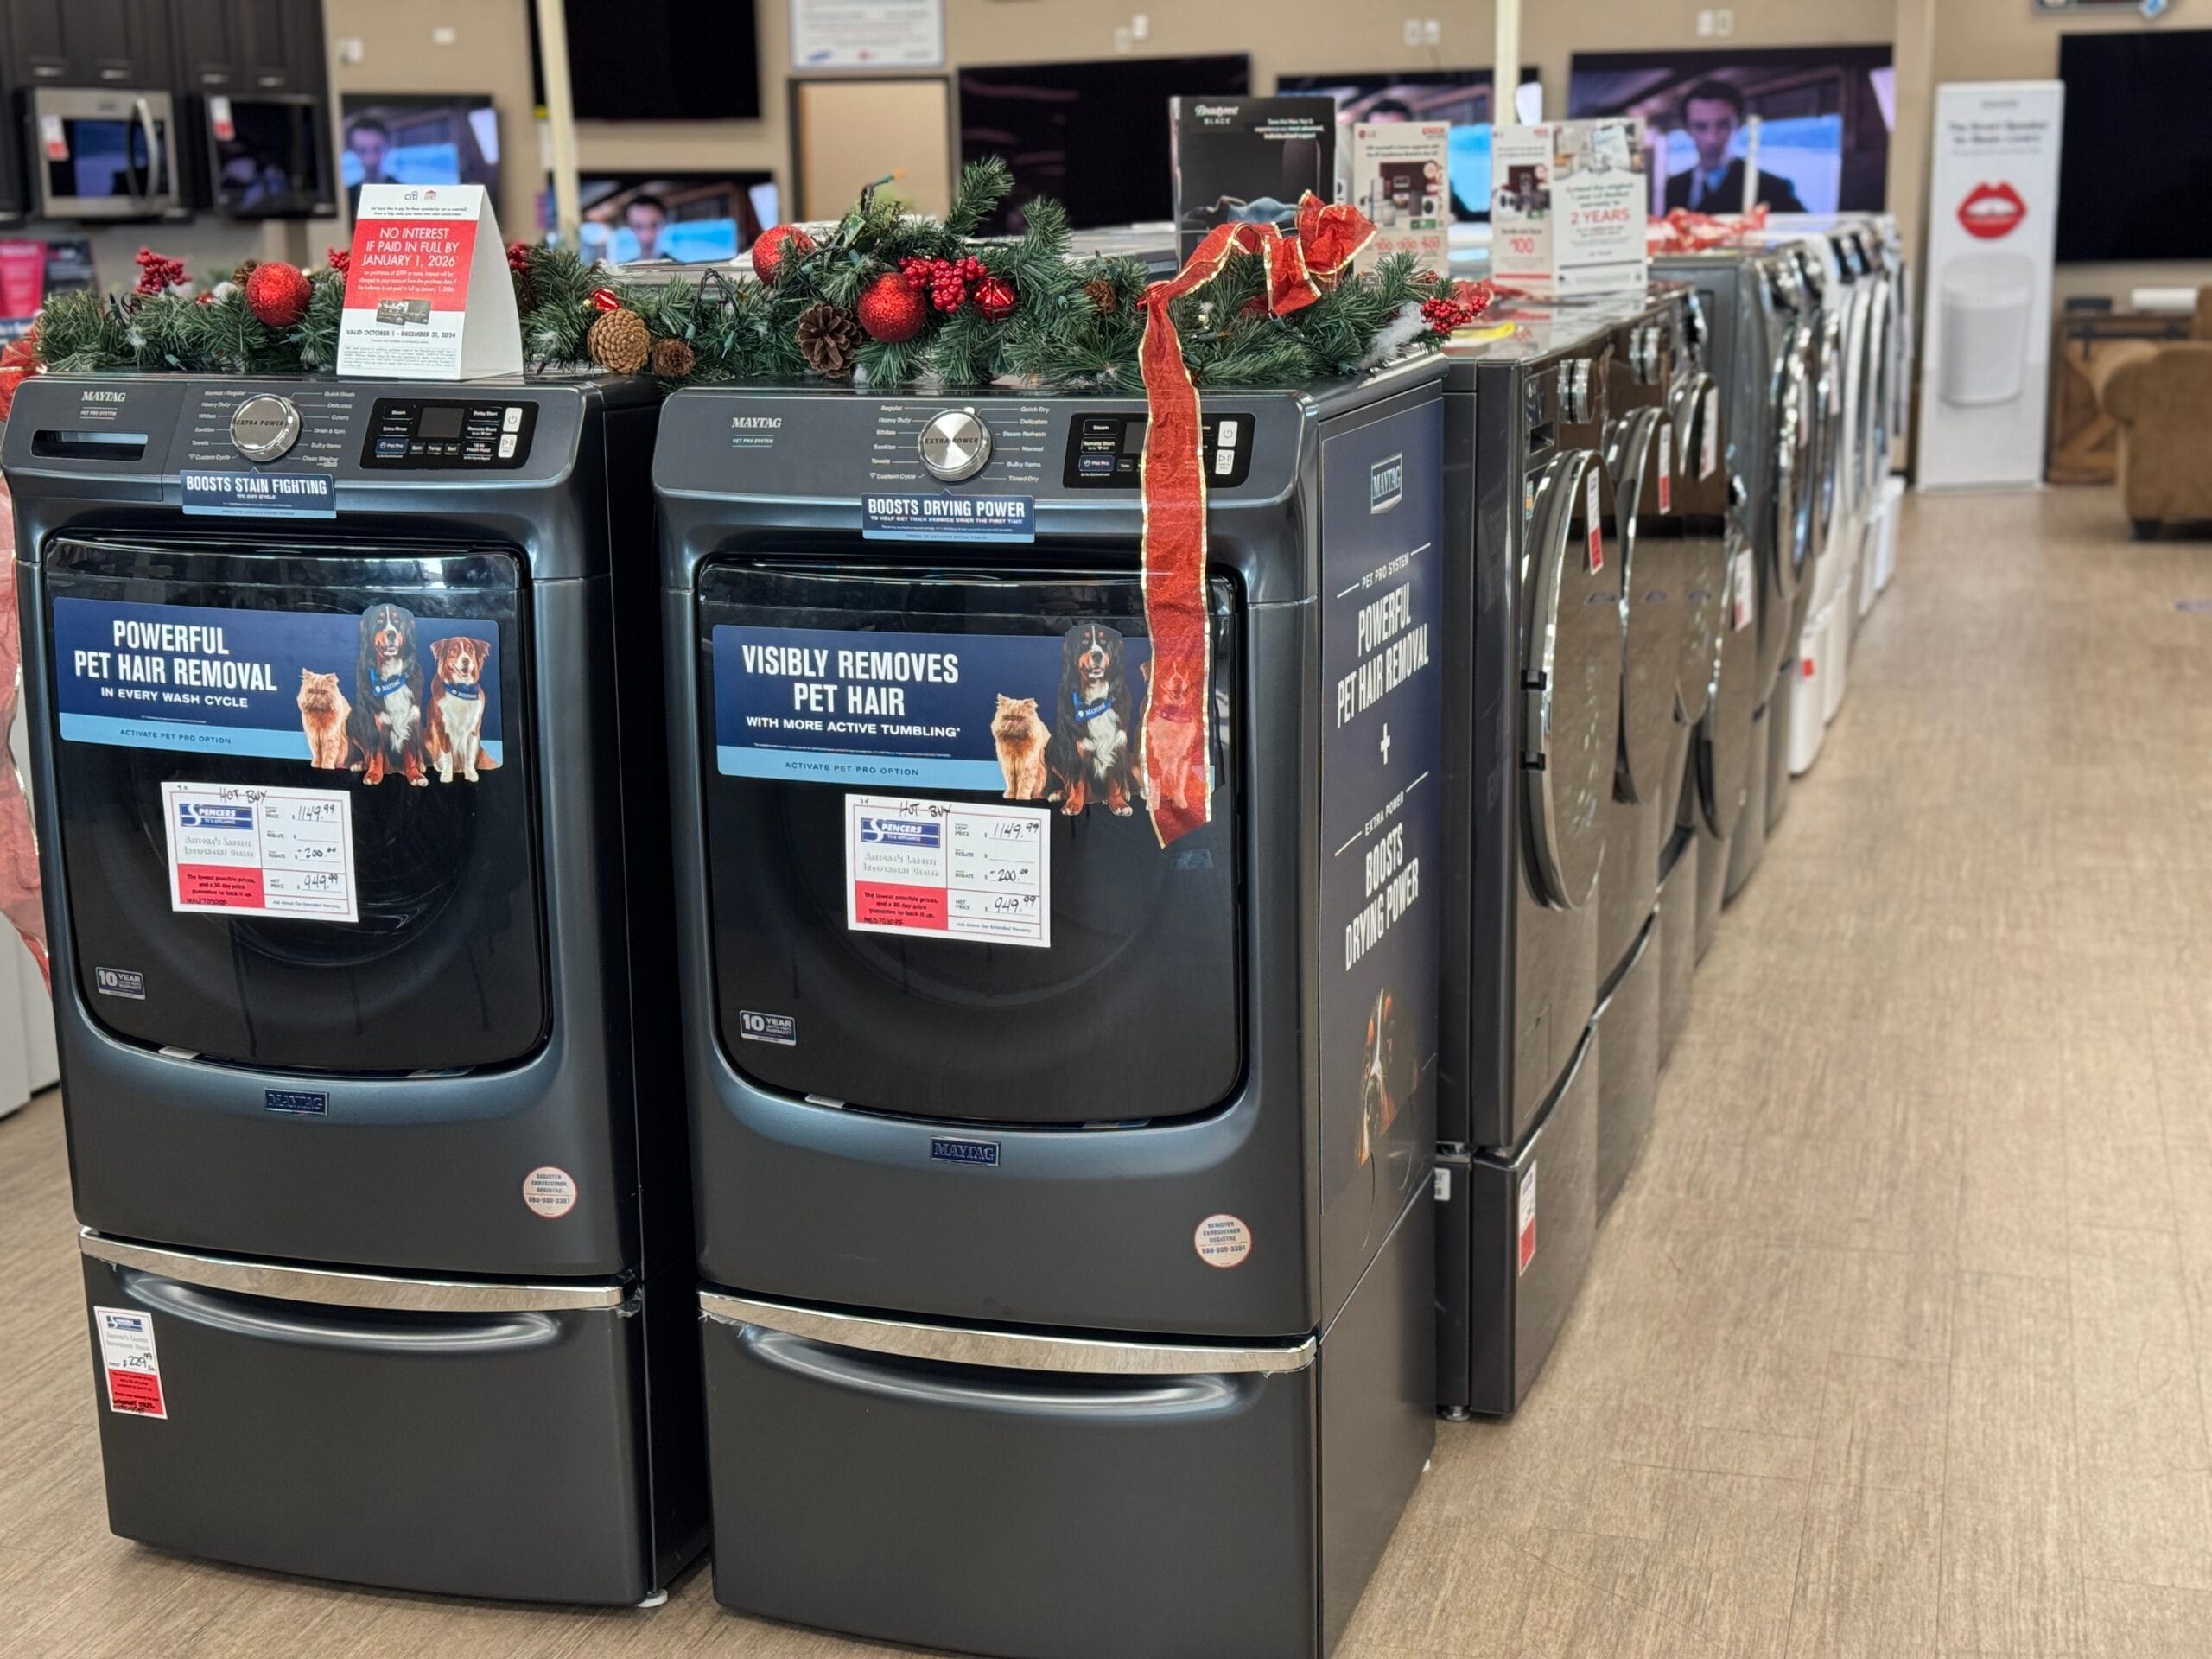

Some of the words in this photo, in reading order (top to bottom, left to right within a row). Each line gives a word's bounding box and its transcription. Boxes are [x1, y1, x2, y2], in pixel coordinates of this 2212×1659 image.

[404, 191, 418, 200] citi
[1571, 213, 1579, 225] 2
[1583, 208, 1630, 224] YEARS
[380, 227, 399, 239] NO
[403, 227, 449, 239] INTEREST
[366, 241, 375, 252] IF
[378, 241, 402, 252] PAID
[404, 241, 417, 252] IN
[421, 242, 442, 252] FULL
[445, 242, 460, 252] BY
[361, 255, 411, 266] JANUARY
[416, 256, 423, 269] 1,
[428, 256, 456, 267] 2026
[81, 391, 126, 402] MAYTAG
[731, 417, 782, 428] MAYTAG
[187, 476, 232, 493] BOOSTS
[235, 477, 269, 493] STAIN
[272, 479, 327, 495] FIGHTING
[868, 499, 919, 515] BOOSTS
[924, 500, 971, 517] DRYING
[976, 502, 1025, 518] POWER
[1362, 573, 1373, 590] PET
[1375, 565, 1387, 584] PRO
[1388, 552, 1409, 575] SYSTEM
[1358, 582, 1411, 658] POWERFUL
[112, 620, 229, 655] POWERFUL
[74, 650, 111, 679] PET
[118, 653, 167, 684] HAIR
[175, 658, 277, 691] REMOVAL
[742, 645, 829, 677] VISIBLY
[838, 650, 959, 683] REMOVES
[1338, 671, 1357, 728] PET
[1358, 653, 1384, 713] HAIR
[1386, 623, 1429, 693] REMOVAL
[101, 687, 114, 697] IN
[118, 688, 158, 702] EVERY
[163, 692, 200, 705] WASH
[205, 695, 248, 708] CYCLE
[794, 683, 838, 712] PET
[848, 685, 906, 716] HAIR
[746, 715, 779, 728] WITH
[784, 718, 823, 732] MORE
[827, 721, 877, 734] ACTIVE
[120, 728, 158, 739] ACTIVATE
[199, 735, 232, 745] OPTION
[785, 761, 830, 772] ACTIVATE
[856, 766, 876, 774] PRO
[880, 766, 919, 776] OPTION
[220, 788, 238, 803] HOT
[245, 789, 268, 804] BUY
[188, 804, 236, 826] SPENCERS
[899, 800, 920, 817] HOT
[929, 804, 951, 817] BUY
[1364, 810, 1384, 836] EXTRA
[1386, 791, 1403, 818] POWER
[870, 818, 923, 842] SPENCERS
[1365, 822, 1403, 898] BOOSTS
[1345, 893, 1384, 972] DRYING
[1386, 857, 1419, 930] POWER
[99, 970, 118, 987] 10
[118, 973, 140, 982] YEAR
[743, 1014, 765, 1031] 10
[766, 1018, 791, 1027] YEAR
[934, 1143, 995, 1160] MAYTAG
